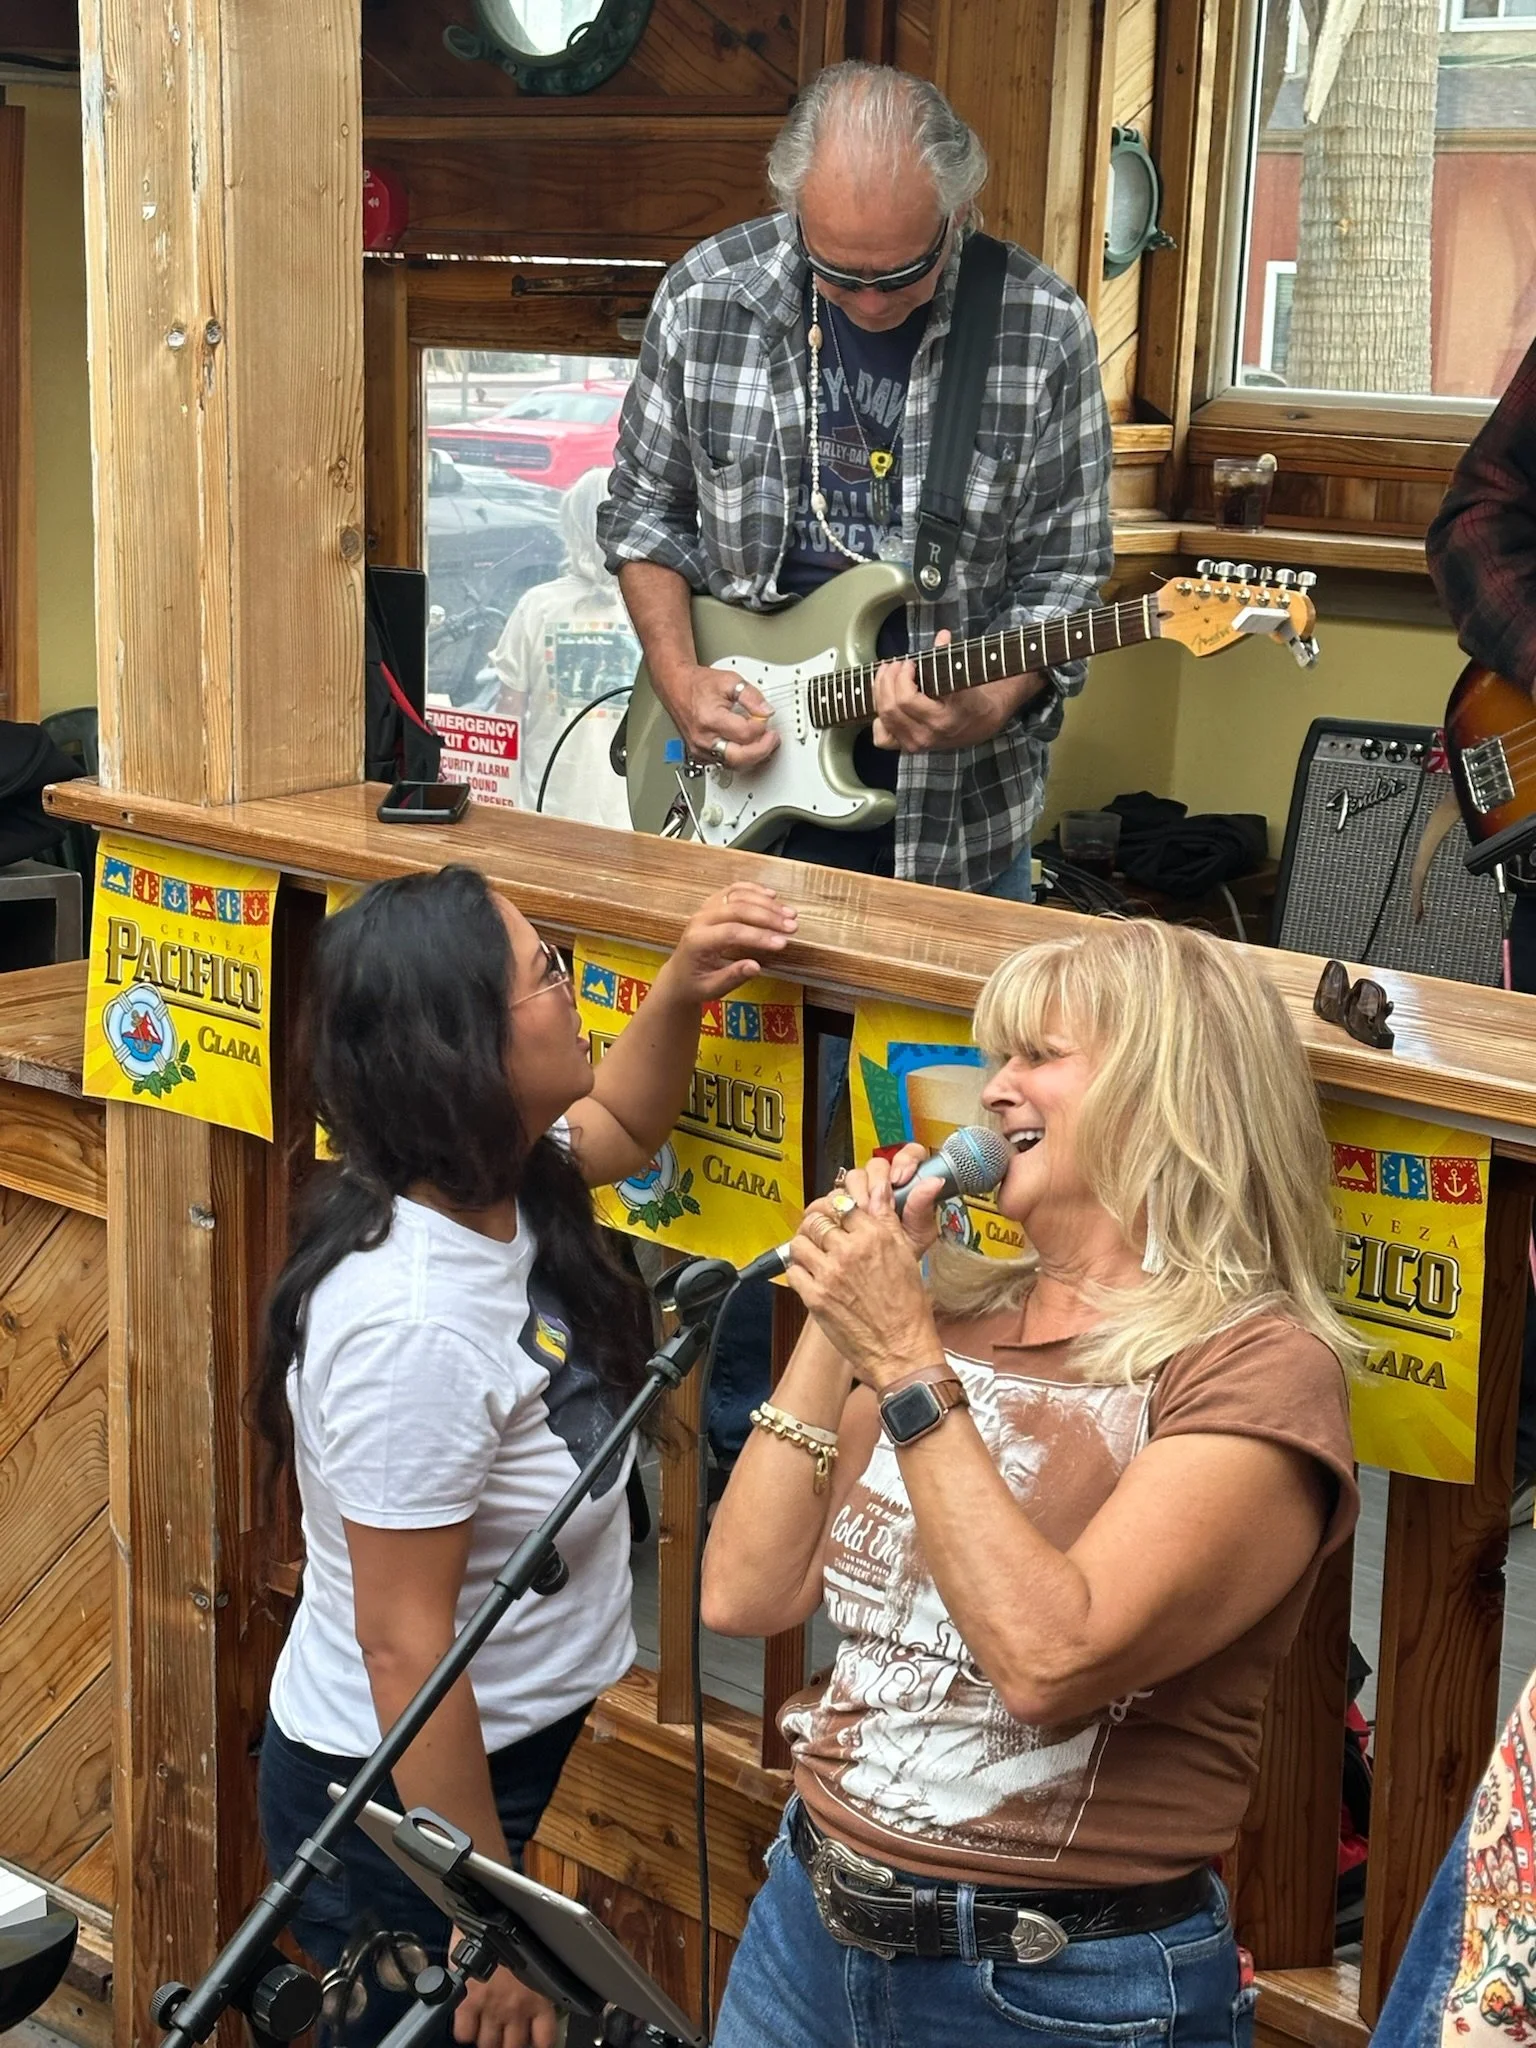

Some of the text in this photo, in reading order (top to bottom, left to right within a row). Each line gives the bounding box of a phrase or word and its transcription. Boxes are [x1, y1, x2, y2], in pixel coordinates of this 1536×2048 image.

[425, 711, 516, 738] EMERGENCY
[467, 735, 507, 756] ONLY
[441, 756, 509, 778] CURITY ALARM
[1326, 776, 1406, 832] Fender
[160, 923, 261, 961] CERVEZA
[105, 917, 263, 1013] PACIFICO
[198, 1025, 262, 1067] CLARA
[697, 1050, 784, 1084] RVEZA
[702, 1154, 782, 1203] CLARA
[1333, 1207, 1460, 1250] RVEZA
[1328, 1230, 1462, 1320] FICO
[1363, 1350, 1448, 1390] LARA
[831, 1504, 874, 1553] Cold
